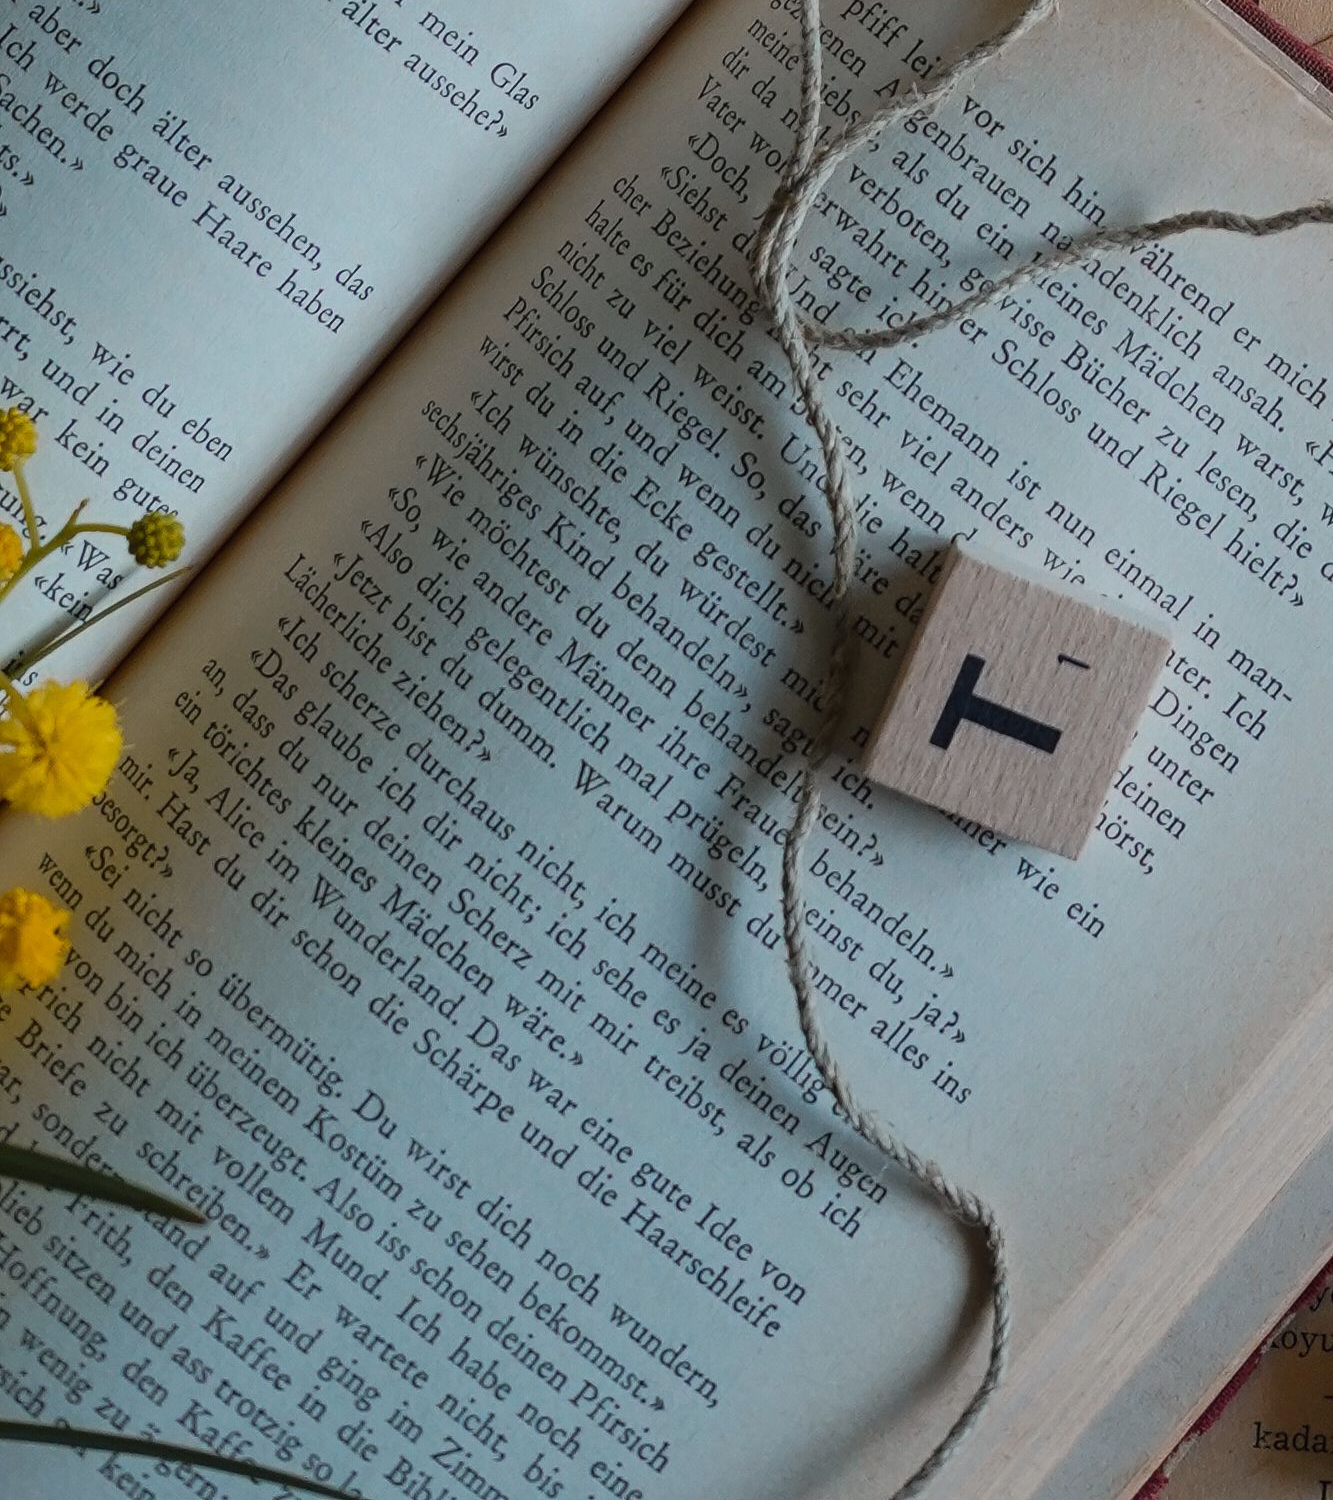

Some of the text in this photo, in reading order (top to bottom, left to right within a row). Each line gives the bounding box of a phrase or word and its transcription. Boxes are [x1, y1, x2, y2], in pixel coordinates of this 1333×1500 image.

[402, 53, 509, 139] aussehe?»
[112, 143, 346, 335] graue Haare haben
[1262, 351, 1329, 411] mich
[478, 334, 805, 635] wirst du in die Ecke gestellt.»
[990, 338, 1305, 608] Schloss und Riegel hielt?»
[929, 654, 1062, 754] T
[1058, 654, 1089, 669] 1
[465, 1014, 808, 1307] Das war eine gute Idee von
[718, 1057, 889, 1206] deinen Augen
